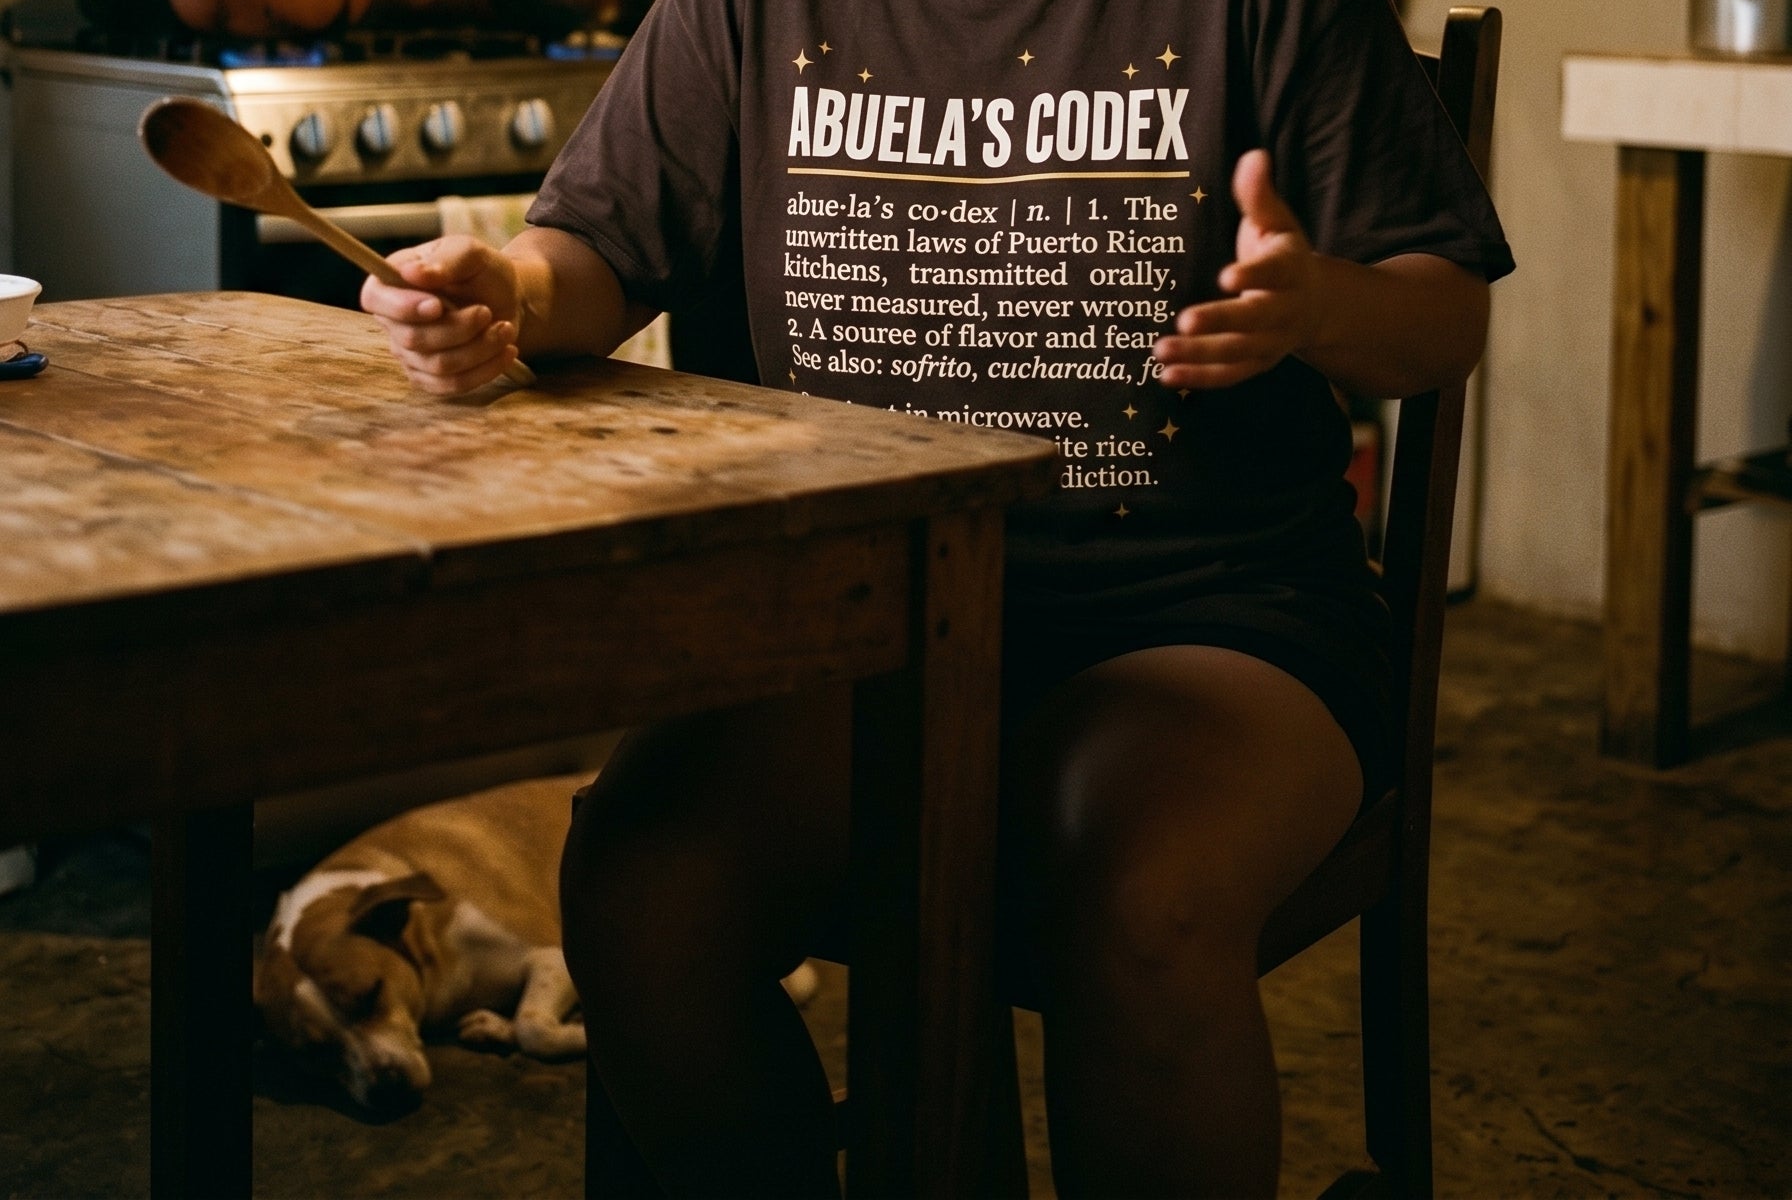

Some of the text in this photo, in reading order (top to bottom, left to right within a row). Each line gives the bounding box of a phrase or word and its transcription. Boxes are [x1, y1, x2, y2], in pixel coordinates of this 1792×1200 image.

[787, 86, 1190, 168] ABUELA’S CODEX
[1026, 204, 1051, 222] n.
[1088, 198, 1109, 222] 1.
[1124, 196, 1178, 221] The
[785, 225, 1186, 255] unwritten laws of Puerto Rican
[783, 253, 1177, 291] kitchens, transmitted orally,
[785, 289, 1176, 323] never measured, never wrong.
[787, 318, 1160, 349] 2. A souree of flavor and fear
[791, 343, 822, 370] See
[827, 349, 883, 375] also:
[890, 353, 979, 383] sofrito,
[987, 354, 1132, 385] cucharada,
[936, 404, 1089, 429] microwave.
[1054, 434, 1153, 458] ite rice.
